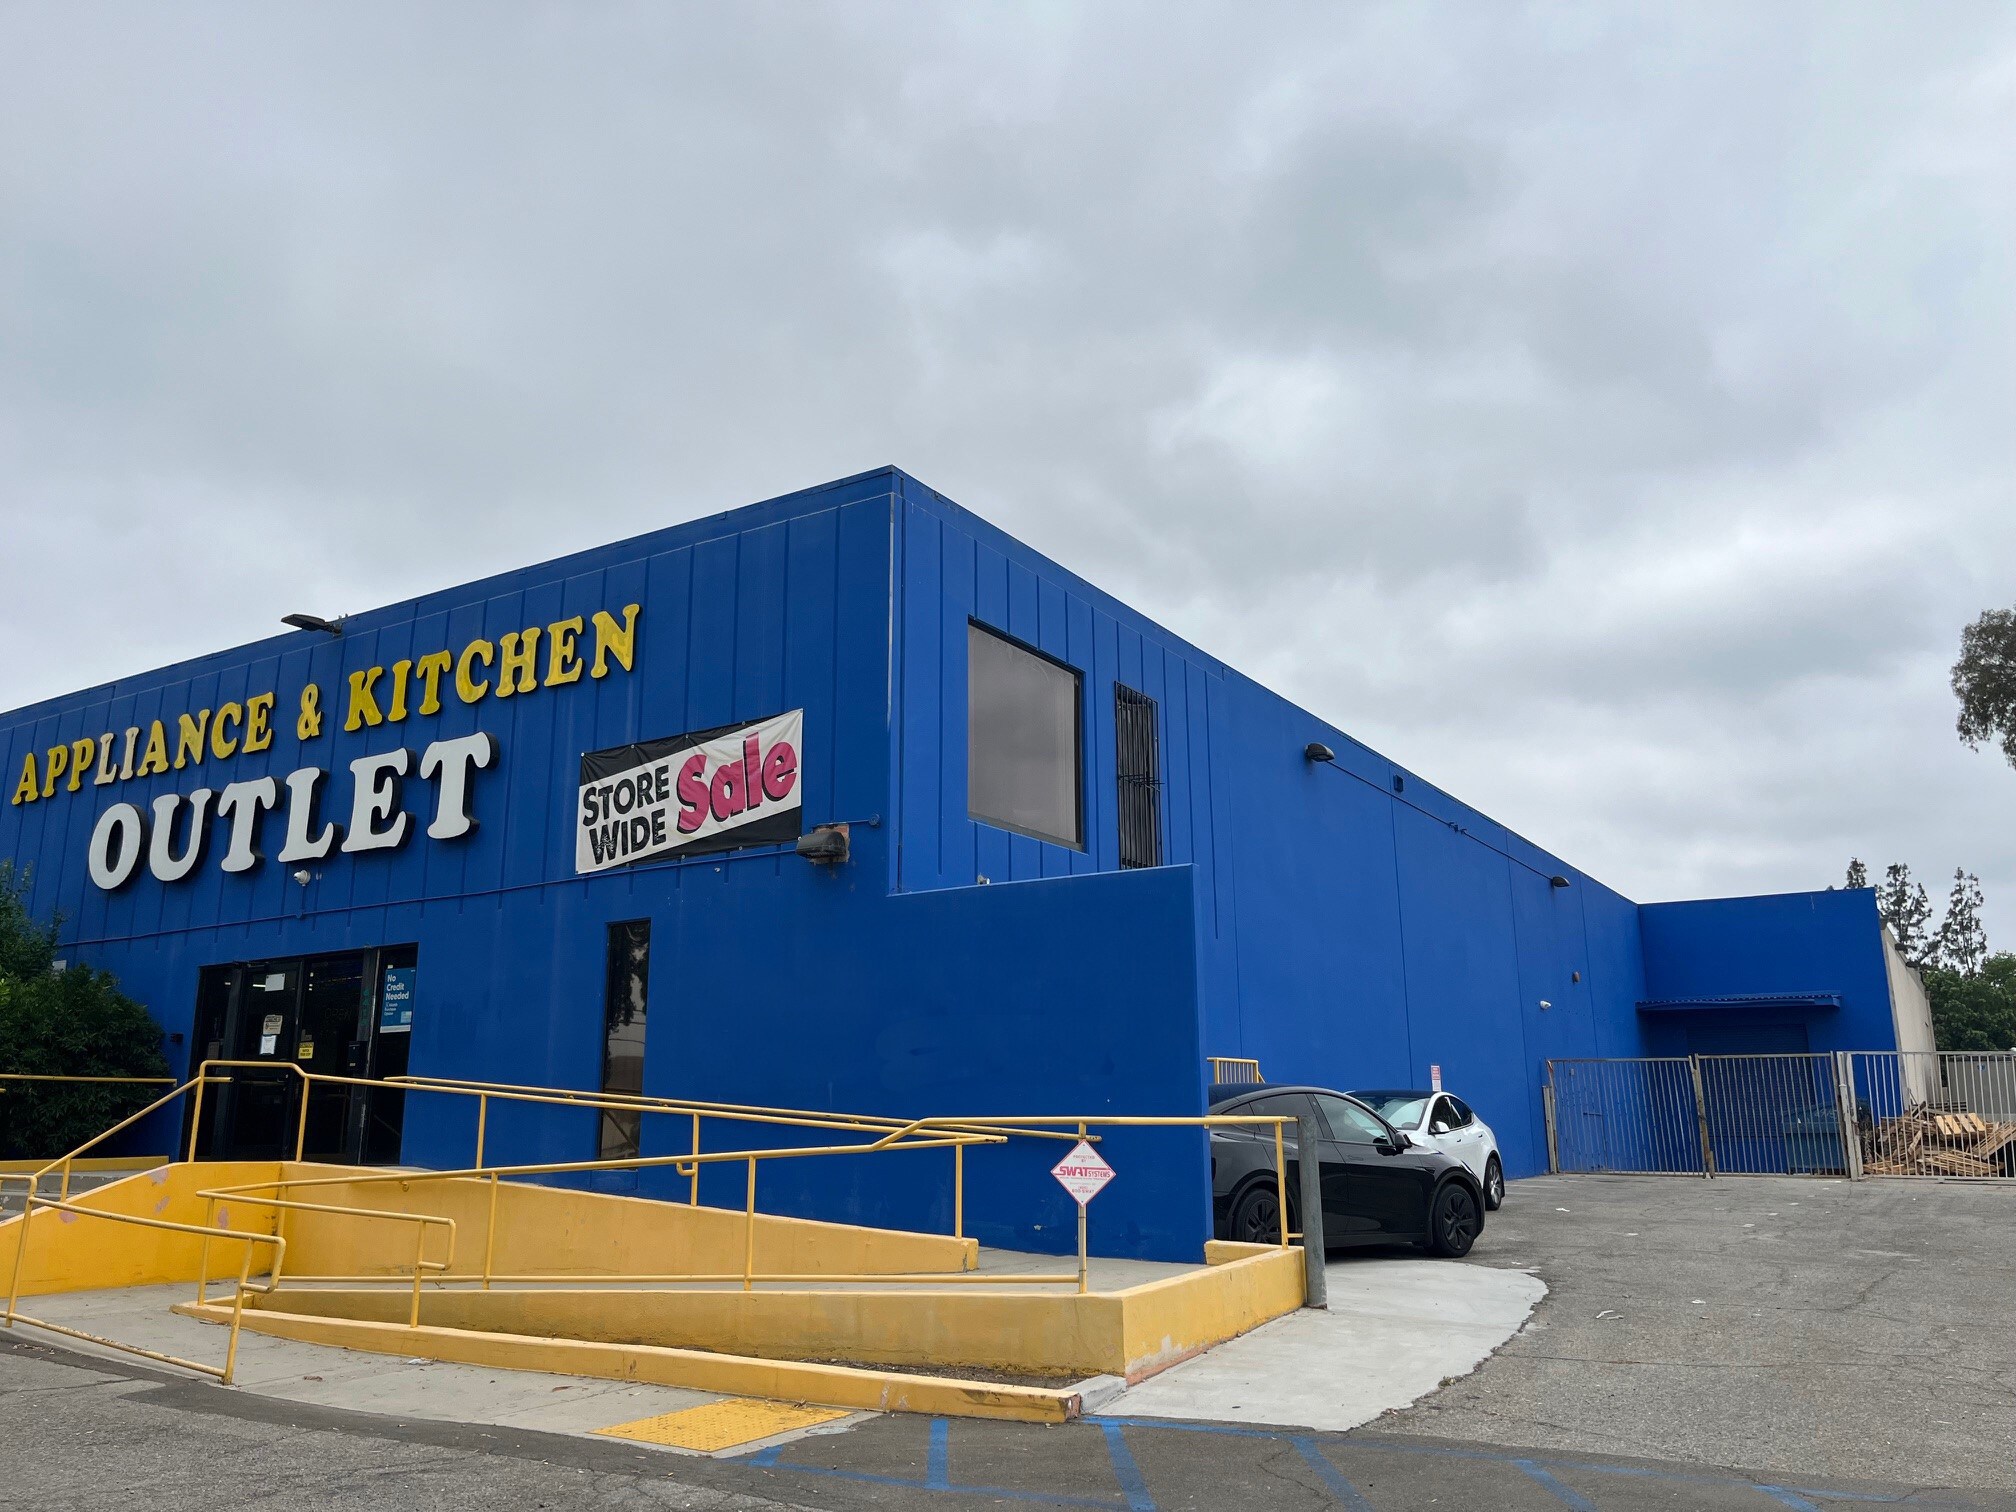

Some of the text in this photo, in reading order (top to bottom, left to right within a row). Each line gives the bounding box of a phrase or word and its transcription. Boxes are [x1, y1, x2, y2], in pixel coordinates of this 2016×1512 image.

[11, 603, 641, 805] APPLIANCE & KITCHEN
[88, 731, 494, 890] OUTLET
[582, 764, 670, 827] STORE
[676, 732, 798, 834] Sale
[589, 808, 667, 865] WIDE
[385, 991, 409, 1000] Needed
[386, 982, 405, 992] Credit
[387, 974, 396, 982] No
[1060, 1166, 1087, 1176] SWAT
